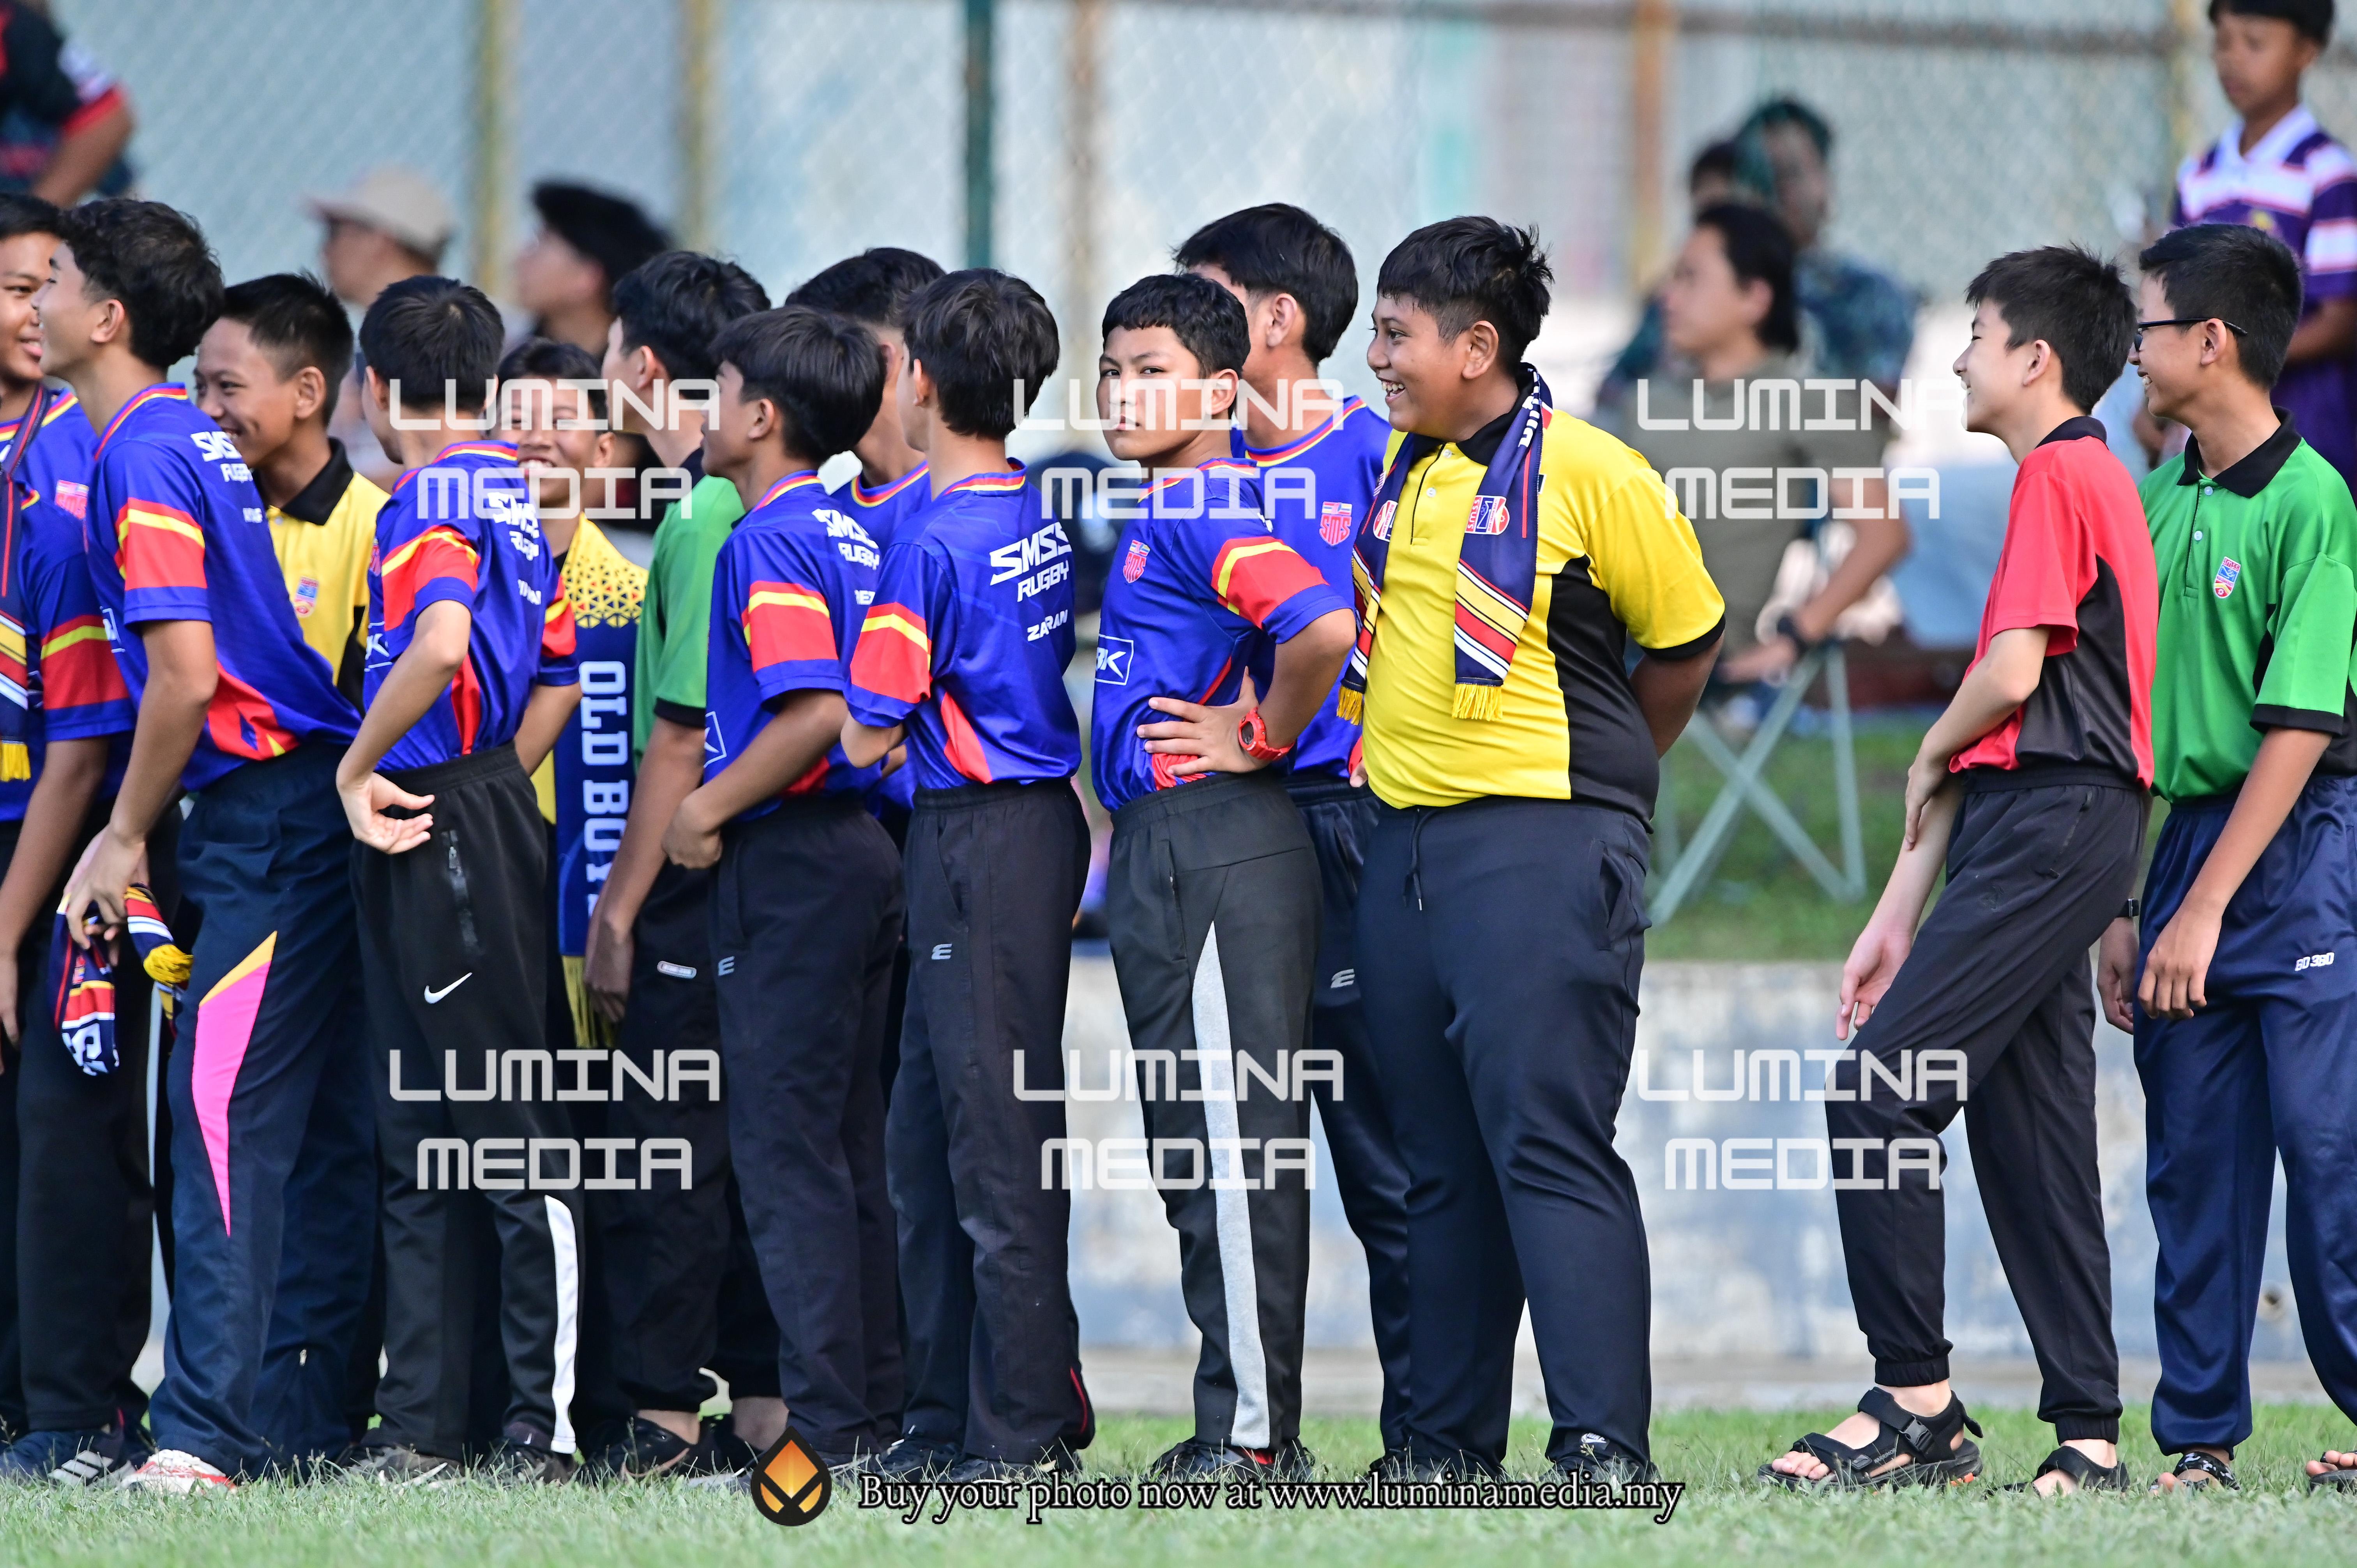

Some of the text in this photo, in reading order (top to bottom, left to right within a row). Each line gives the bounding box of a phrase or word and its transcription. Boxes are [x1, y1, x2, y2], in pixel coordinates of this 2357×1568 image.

[1319, 514, 1352, 546] SMS
[838, 542, 880, 570] RUGBY
[989, 521, 1072, 586] SMSS
[1017, 560, 1069, 602] RUGBY
[1027, 609, 1068, 642] ZARAN
[579, 661, 627, 766] OLD
